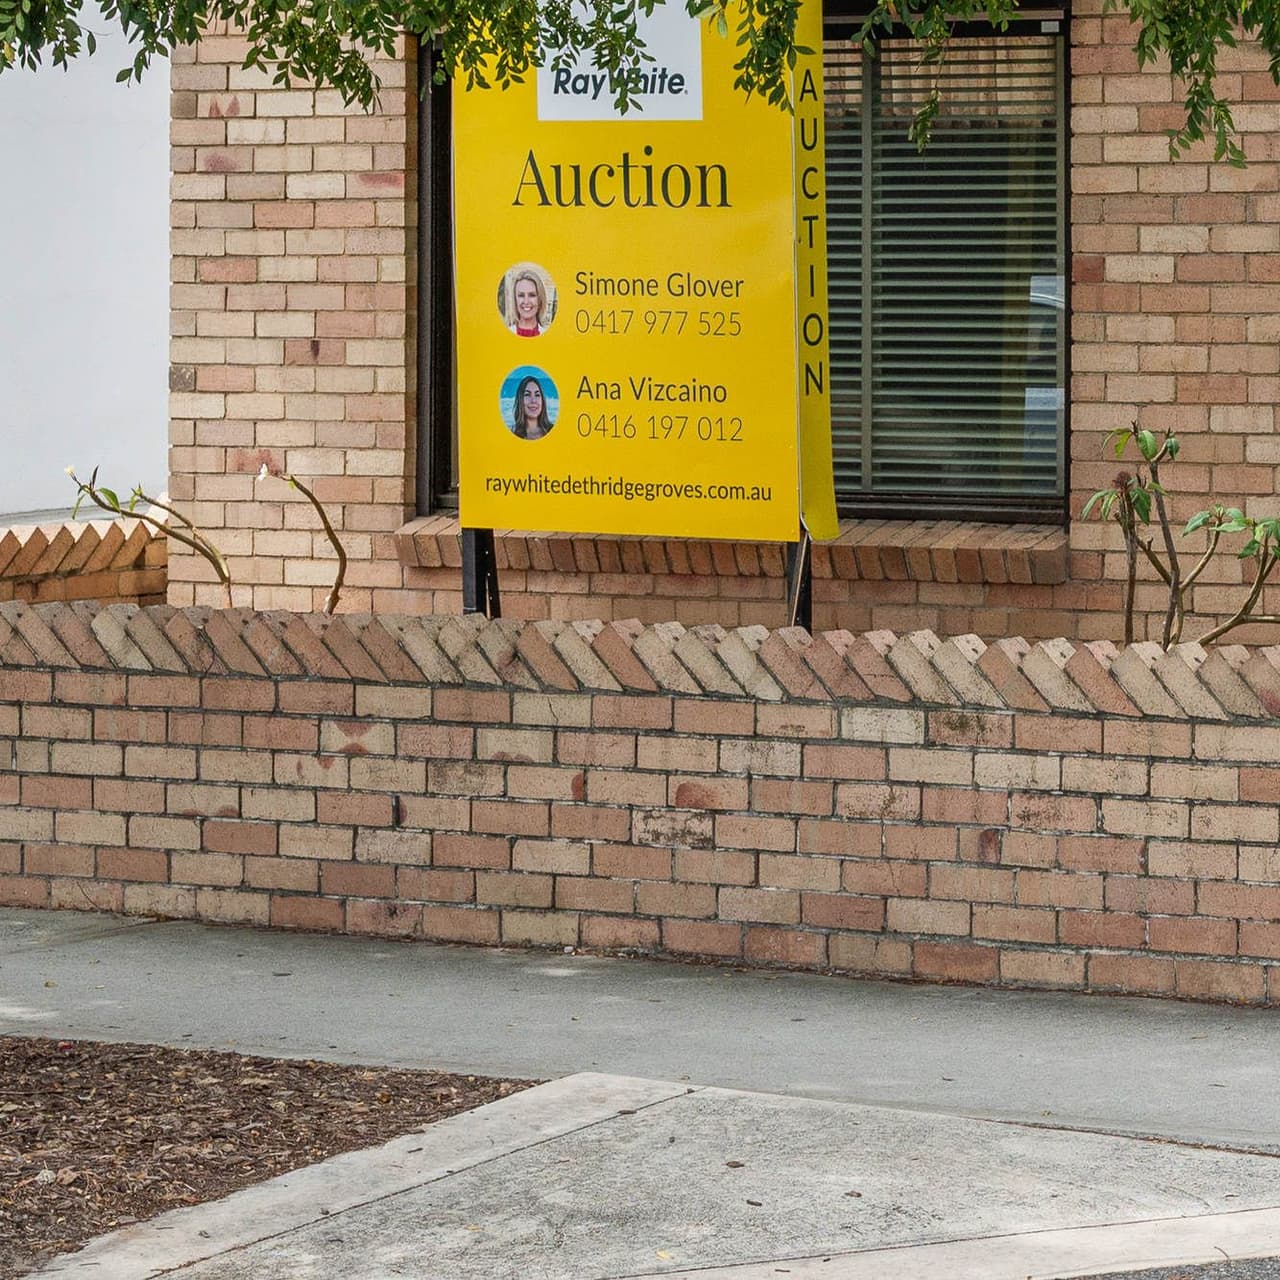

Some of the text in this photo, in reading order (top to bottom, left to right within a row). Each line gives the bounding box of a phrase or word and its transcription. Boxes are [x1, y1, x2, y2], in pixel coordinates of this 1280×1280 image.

[512, 145, 732, 208] Auction
[799, 68, 824, 396] AUCTION
[576, 272, 744, 298] Simone Glover
[576, 310, 742, 337] 0417 977 525
[577, 376, 727, 403] Ana Vizcaino
[577, 413, 743, 442] 0416 197 012
[486, 474, 771, 501] raywhitedethridgegroves.com.au
